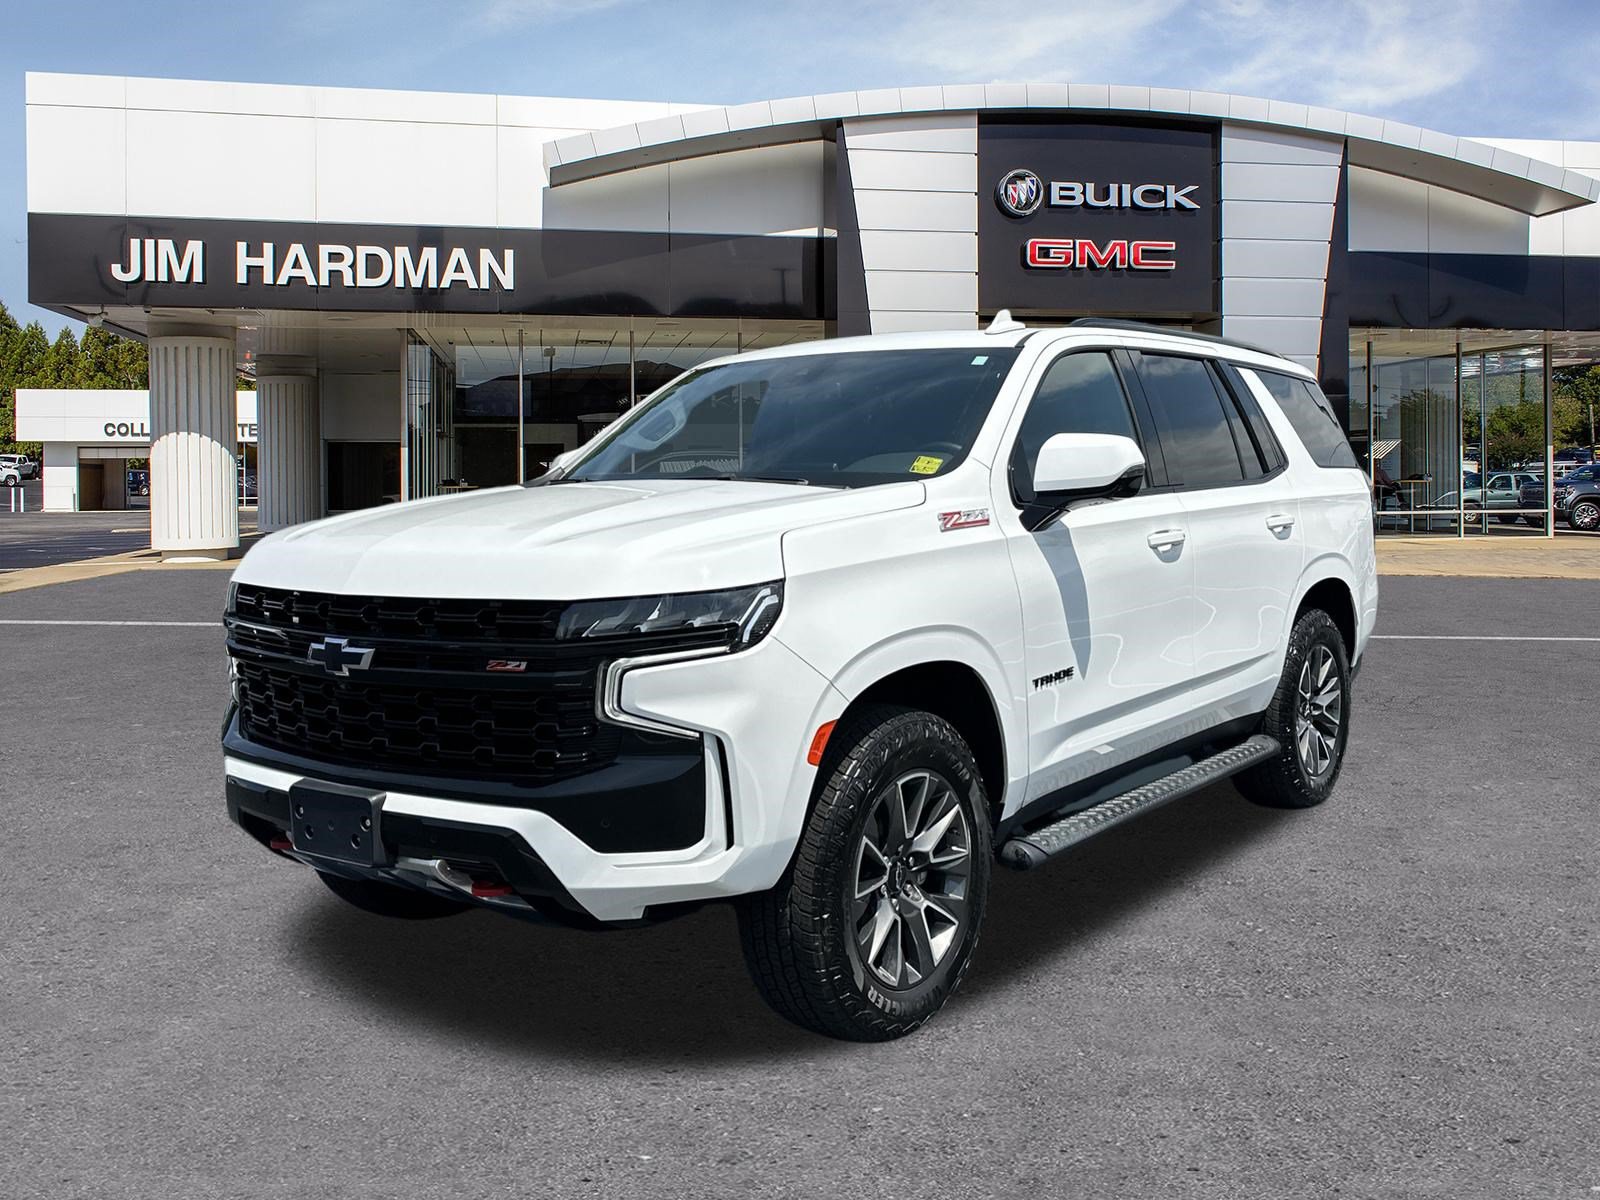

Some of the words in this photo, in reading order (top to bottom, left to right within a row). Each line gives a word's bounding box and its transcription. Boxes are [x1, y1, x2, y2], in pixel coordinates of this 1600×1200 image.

[1050, 181, 1200, 209] BUICK
[111, 238, 204, 283] JIM
[235, 240, 515, 291] HARDMAN
[1026, 238, 1176, 270] GMC
[104, 422, 150, 437] COLL
[1032, 666, 1074, 689] TAHOE
